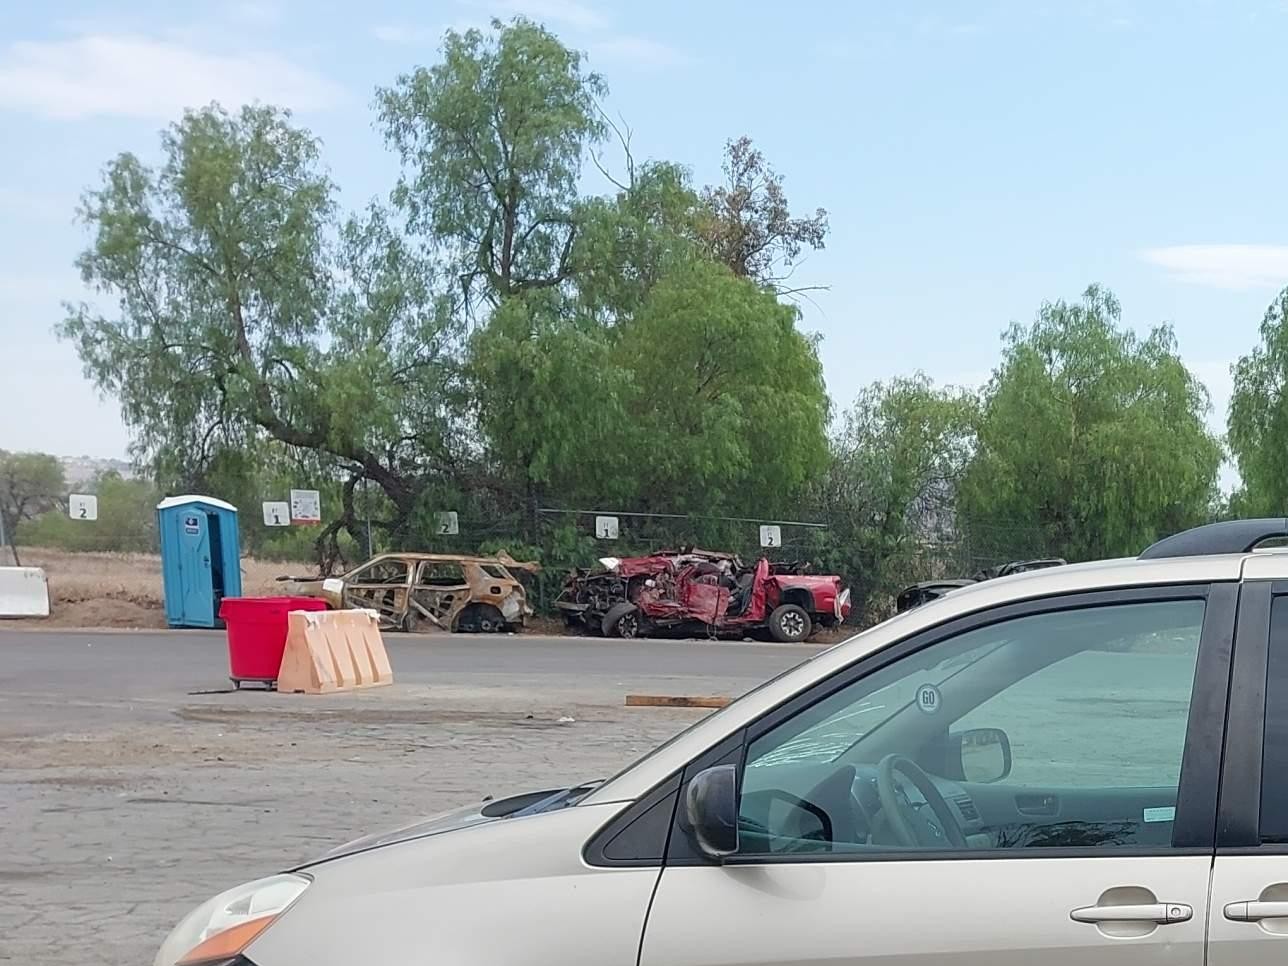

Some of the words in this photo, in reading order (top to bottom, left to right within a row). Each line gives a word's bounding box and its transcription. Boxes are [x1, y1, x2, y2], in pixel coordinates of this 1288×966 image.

[80, 508, 87, 518] 2
[274, 515, 280, 524] 1
[441, 524, 449, 533] 2
[768, 536, 773, 545] 2
